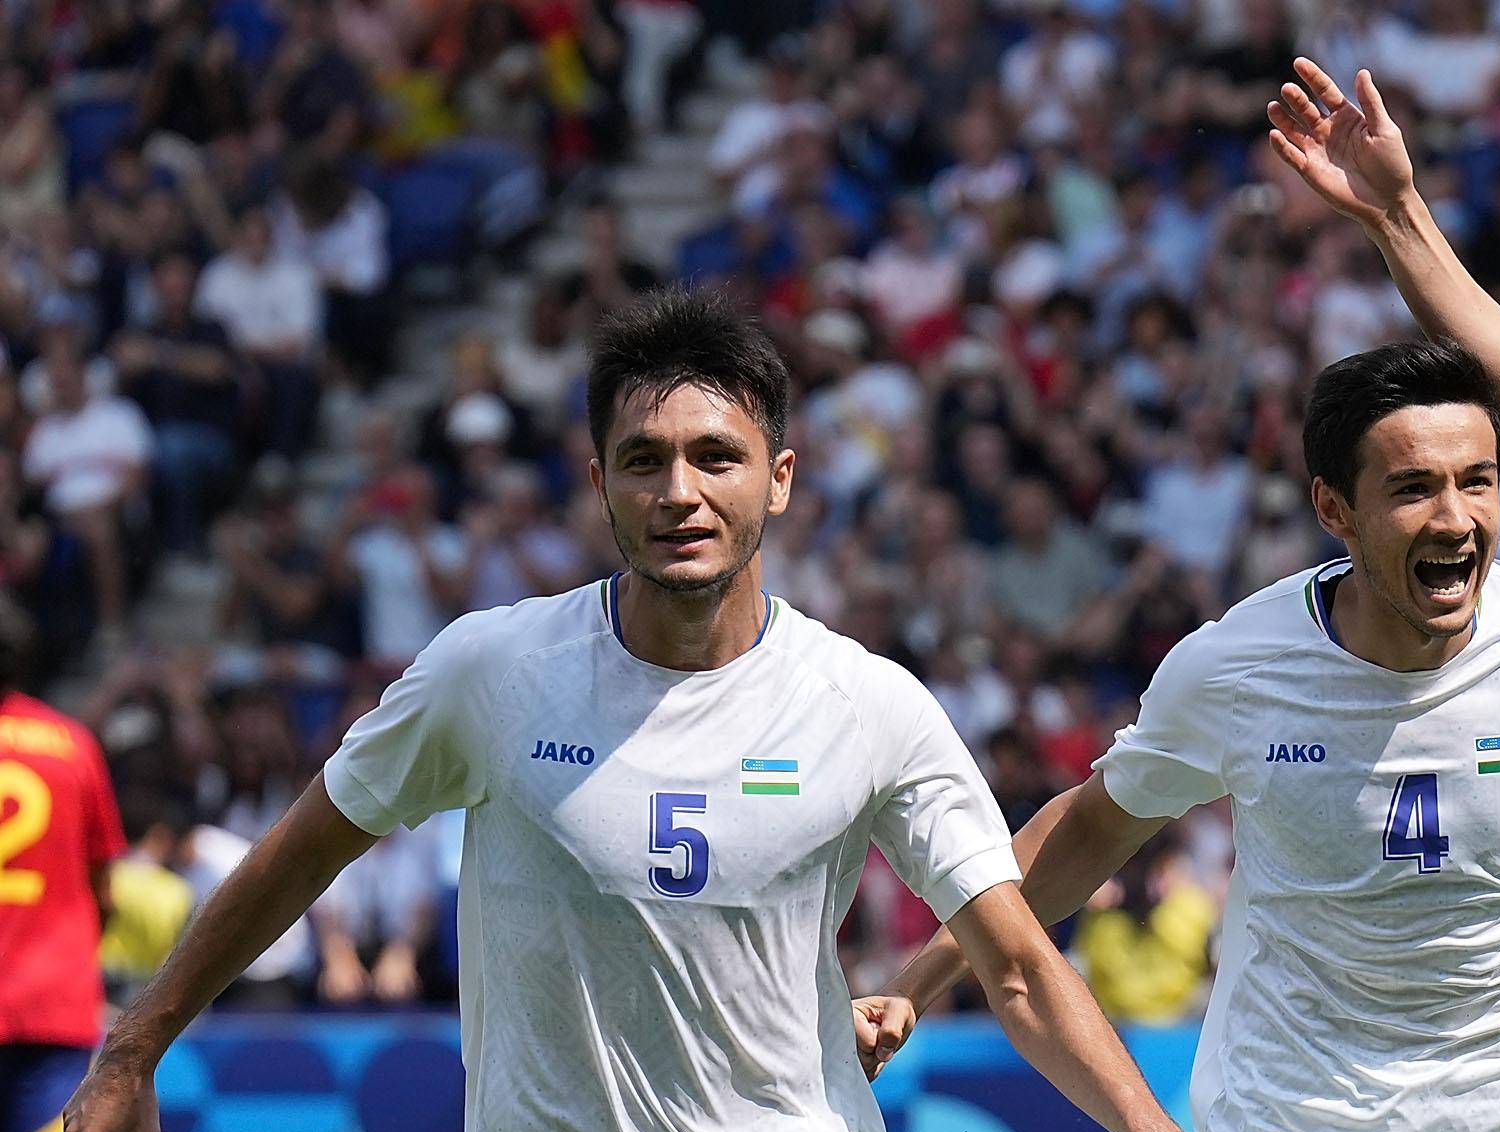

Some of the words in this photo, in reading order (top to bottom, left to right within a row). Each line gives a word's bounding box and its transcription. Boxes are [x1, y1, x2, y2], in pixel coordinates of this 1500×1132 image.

[531, 740, 595, 766] JAKO
[1265, 743, 1326, 763] JAKO
[648, 792, 709, 898] 5
[1382, 773, 1449, 875] 4
